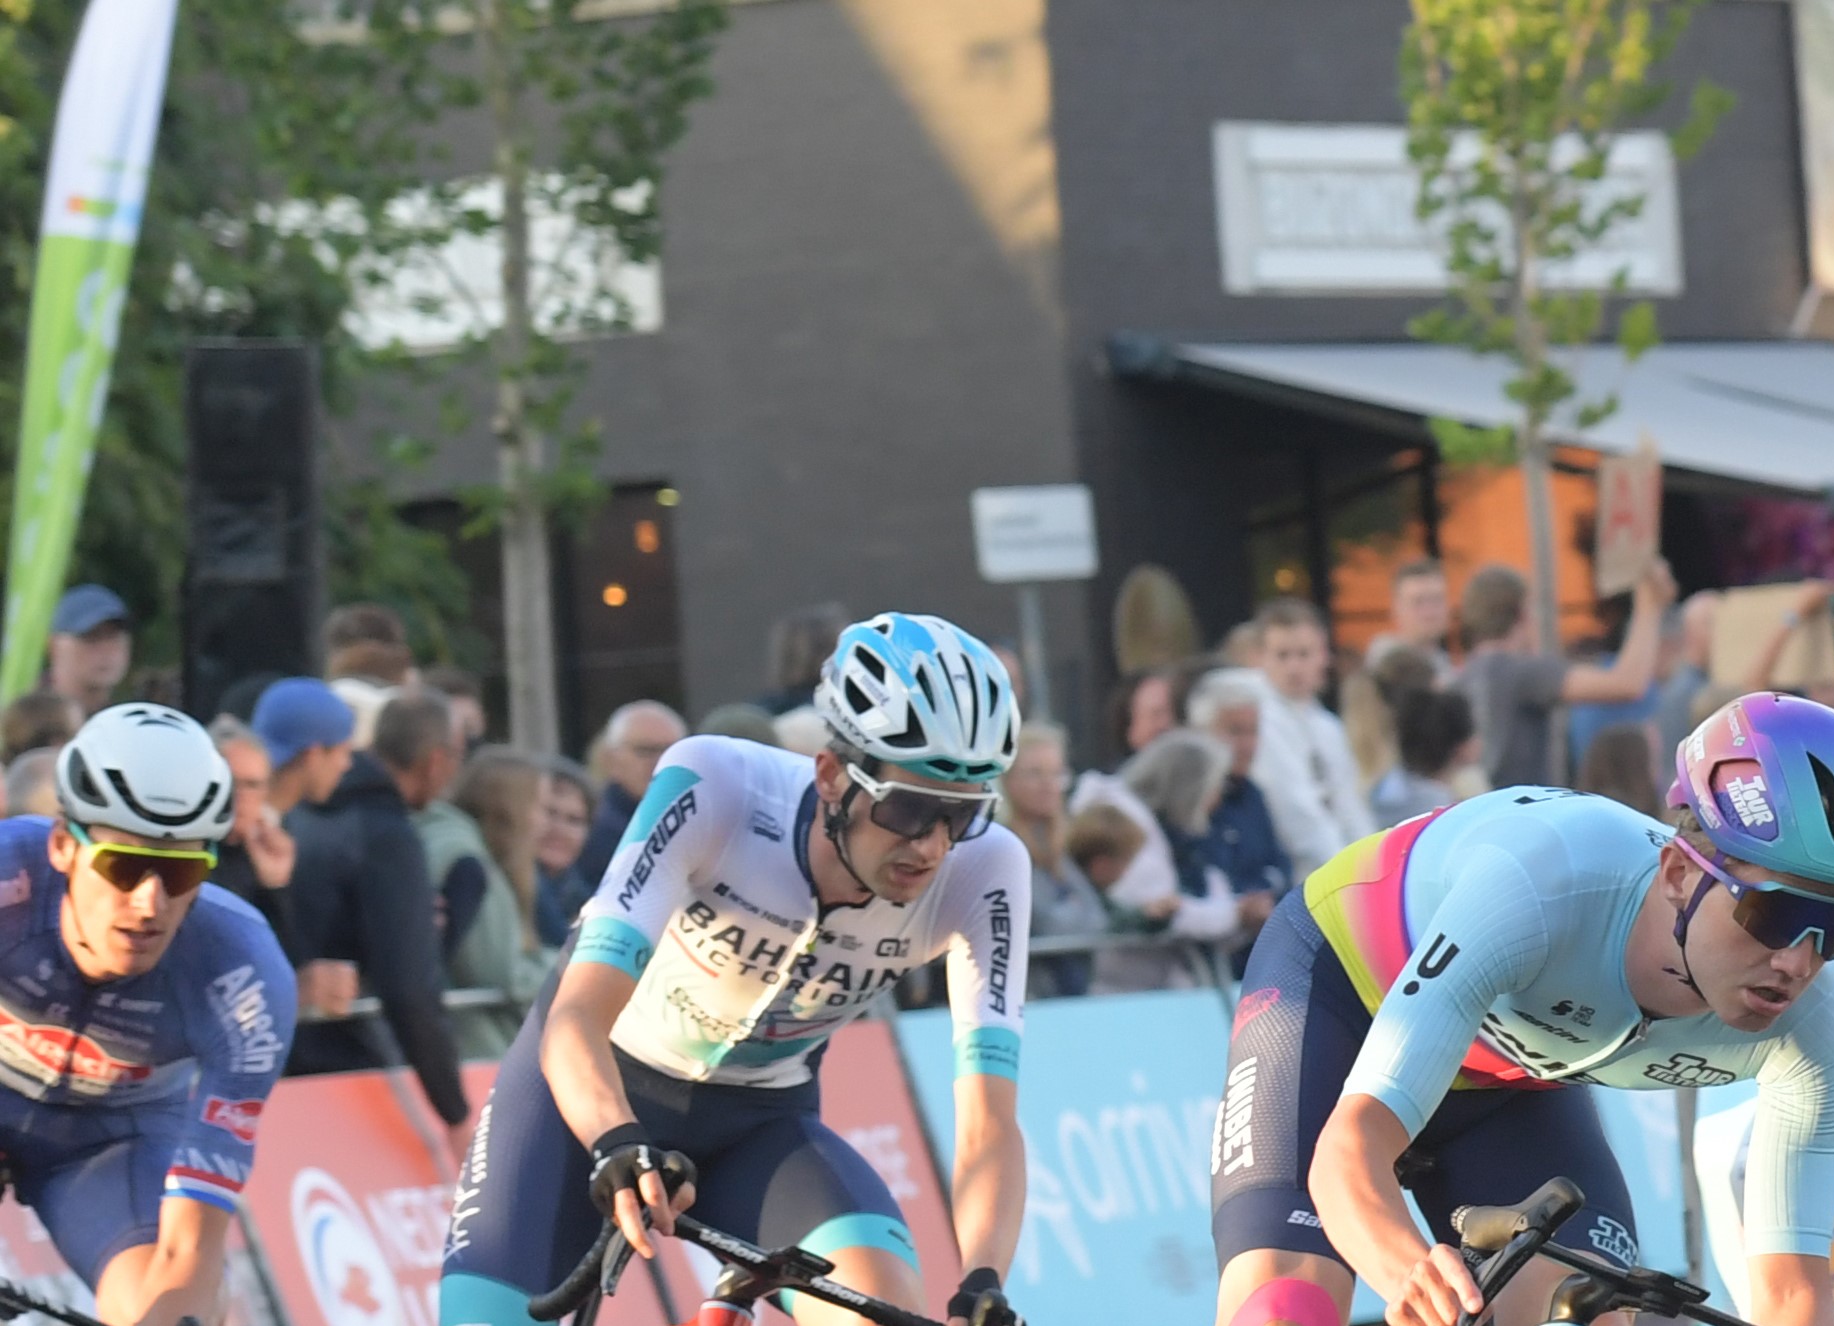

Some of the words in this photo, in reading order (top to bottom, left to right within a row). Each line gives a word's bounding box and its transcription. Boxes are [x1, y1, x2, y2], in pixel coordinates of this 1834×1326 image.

[617, 789, 698, 913] MERIDA
[1751, 775, 1775, 827] TOUR
[685, 900, 910, 992] BAHRAIN
[984, 888, 1011, 1016] MERIDA
[212, 963, 284, 1074] Alpecin
[1224, 1056, 1257, 1176] UNIBET
